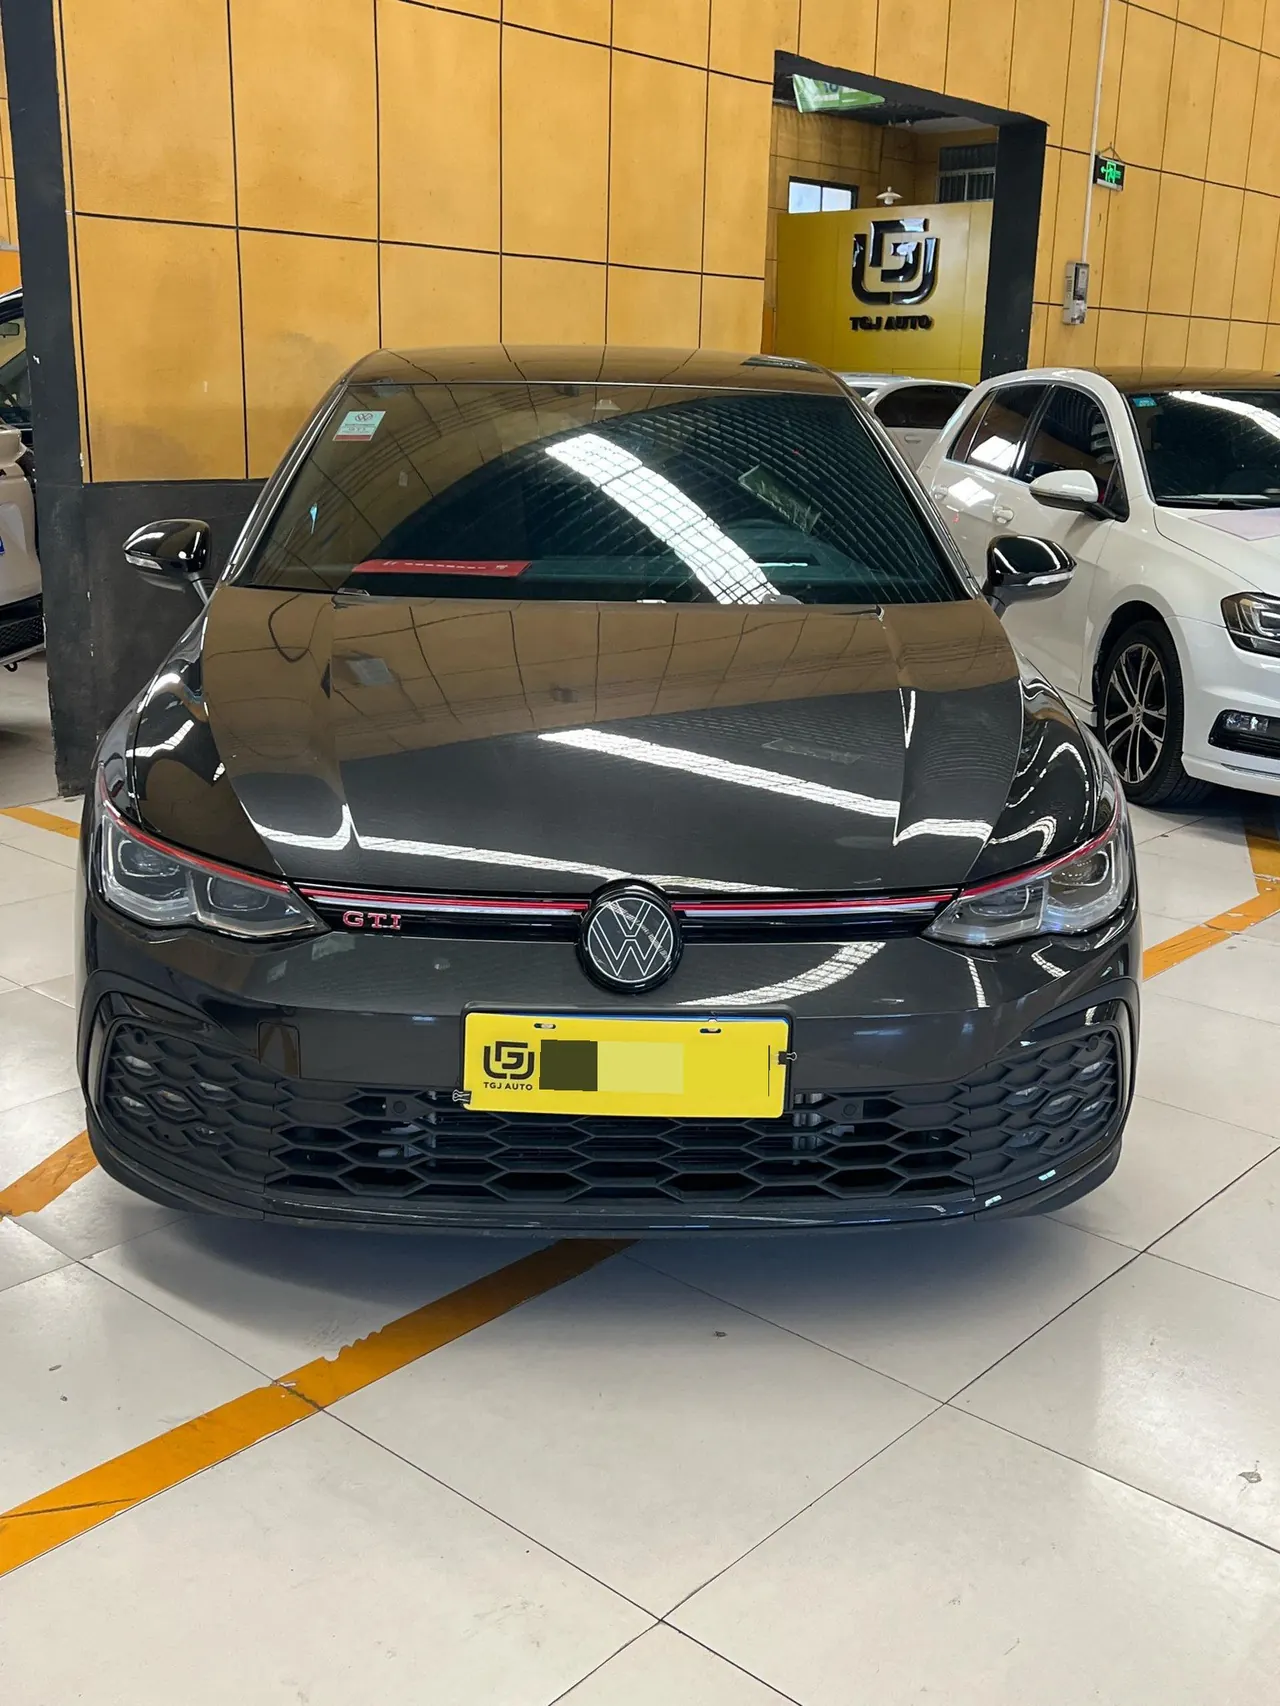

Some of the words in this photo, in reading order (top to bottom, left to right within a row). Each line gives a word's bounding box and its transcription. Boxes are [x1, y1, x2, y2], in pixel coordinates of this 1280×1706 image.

[849, 316, 883, 331] TGJ
[884, 314, 933, 330] AUTO
[342, 910, 402, 930] GTI
[483, 1081, 502, 1090] TGJ
[505, 1082, 533, 1091] AUTO
